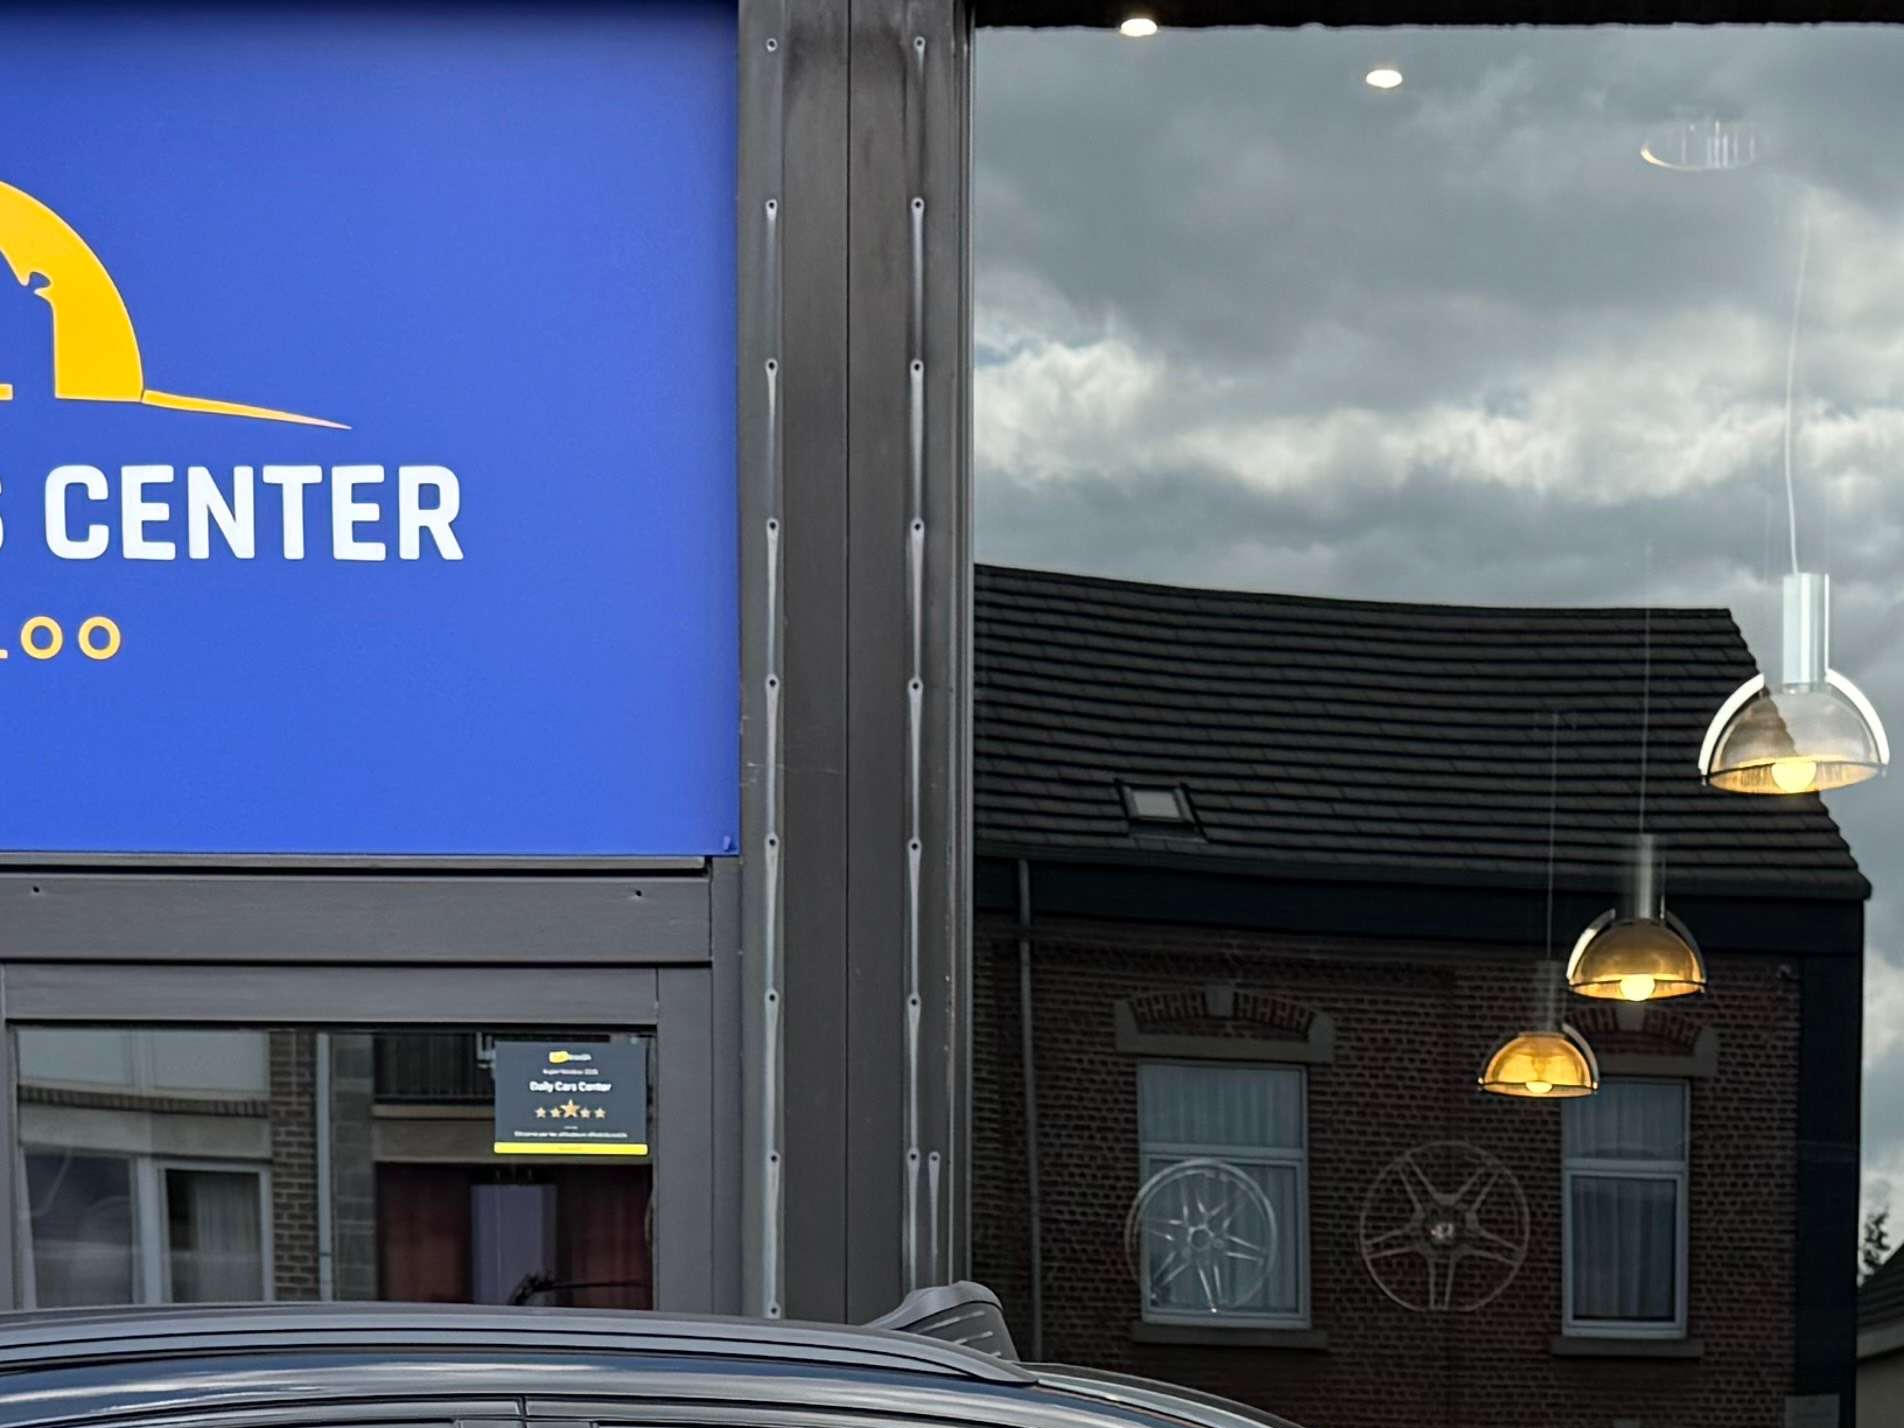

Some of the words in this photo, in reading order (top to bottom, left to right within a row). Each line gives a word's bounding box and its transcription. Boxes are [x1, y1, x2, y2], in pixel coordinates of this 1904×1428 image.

[43, 463, 465, 561] CENTER
[529, 1081, 554, 1093] Daily
[579, 1081, 613, 1092] Center
